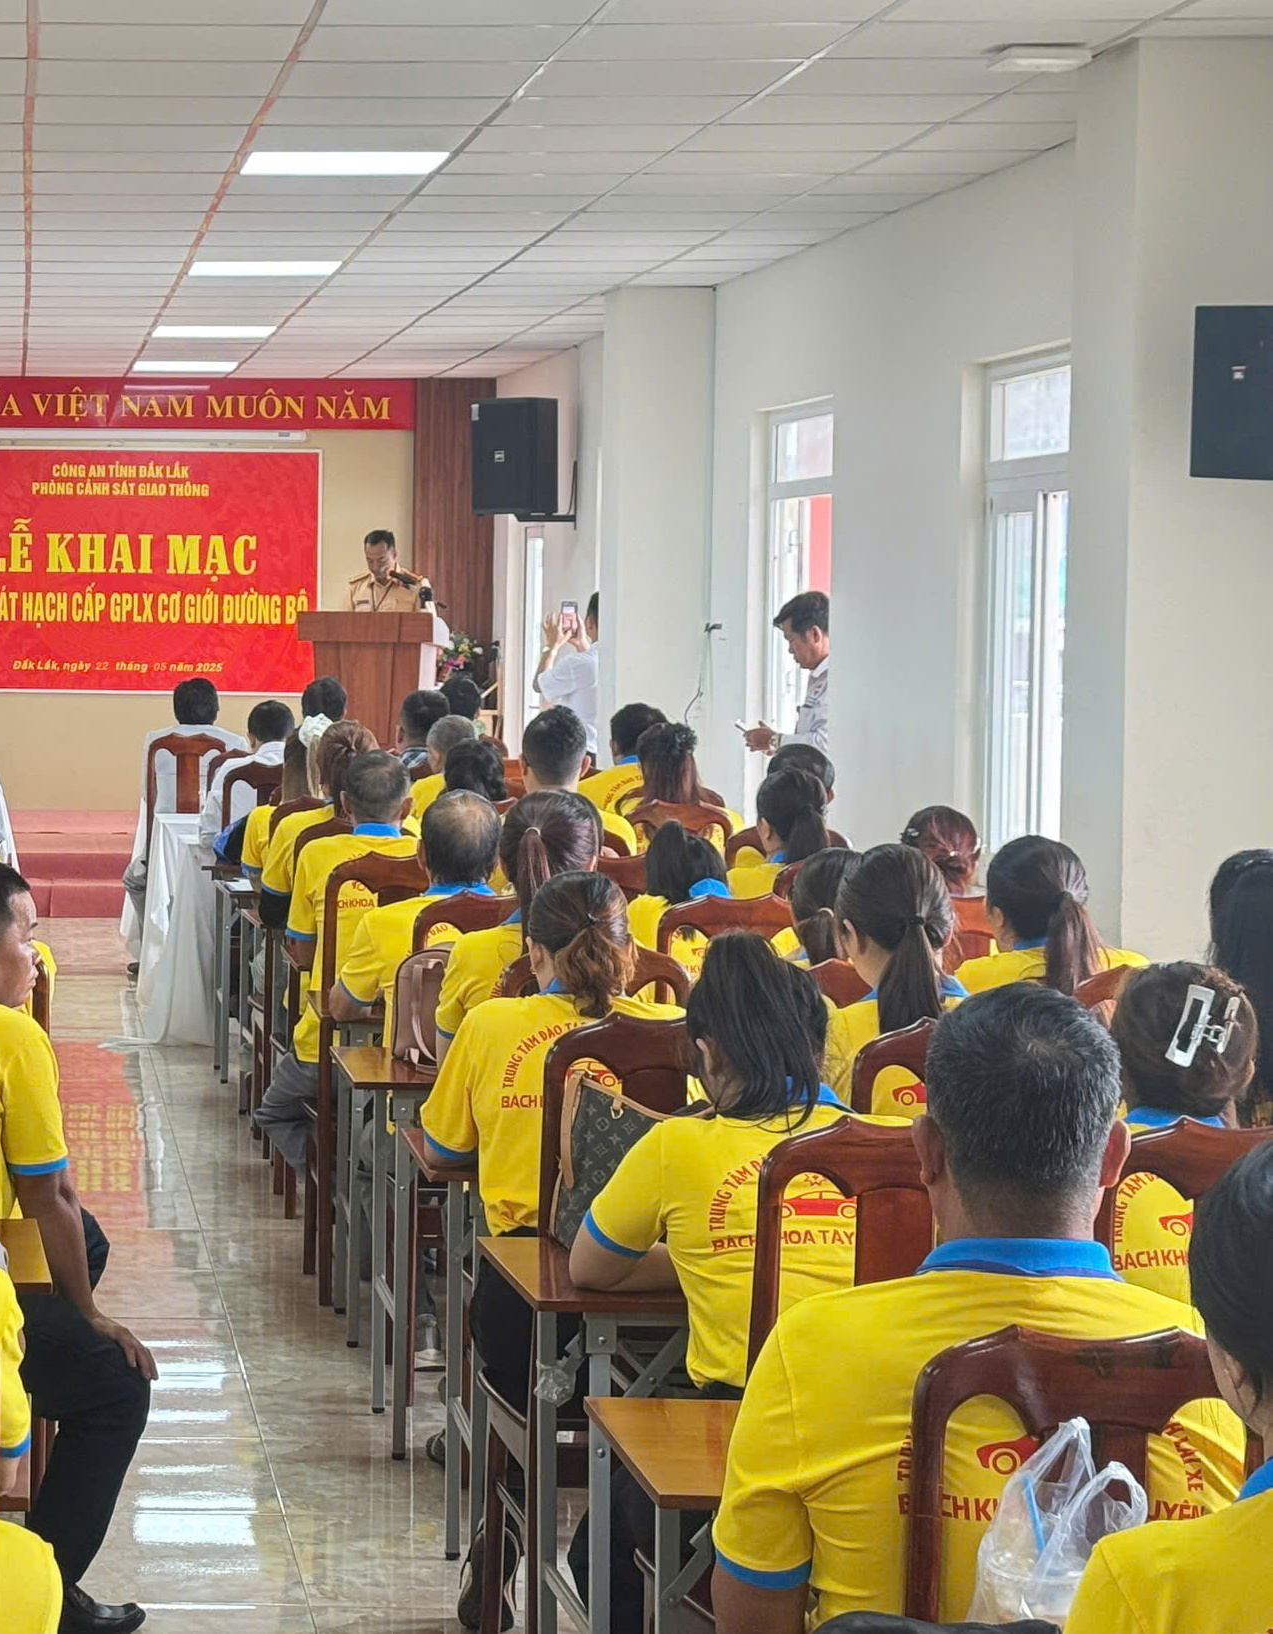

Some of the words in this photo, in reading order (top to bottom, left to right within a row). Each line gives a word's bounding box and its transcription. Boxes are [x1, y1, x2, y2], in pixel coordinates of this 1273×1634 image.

[32, 387, 110, 424] VIỆT
[120, 394, 194, 418] NAM
[205, 388, 305, 419] MUÔN
[315, 390, 391, 420] NĂM
[52, 461, 87, 478] CÔNG
[89, 465, 107, 478] AN
[108, 461, 137, 478] TỈNH
[32, 479, 74, 495] PHÒNG
[76, 479, 110, 495] CẢNH
[112, 480, 136, 495] SÁT
[138, 483, 167, 496] GIAO
[169, 481, 210, 497] THÔNG
[46, 532, 154, 575] KHAI
[166, 534, 258, 582] MẠC
[22, 591, 68, 628] HẠCH
[71, 582, 107, 623] CẤP
[110, 592, 155, 623] GPLX
[158, 591, 182, 623] CƠ
[184, 587, 219, 624] GIỚI
[222, 588, 282, 625] ĐƯỜNG
[12, 659, 35, 670] Đắk
[62, 661, 91, 673] ngày
[95, 662, 109, 671] 22
[115, 661, 149, 673] tháng
[153, 662, 167, 671] 05
[169, 662, 194, 672] năm
[196, 662, 223, 672] 2025
[502, 1053, 523, 1089] TRUNG
[501, 1092, 538, 1109] BÁCH
[709, 1189, 733, 1232] TRUNG
[722, 1165, 754, 1190] TÂM
[781, 1229, 816, 1245] HOA
[818, 1229, 855, 1245] TÂY
[1113, 1249, 1160, 1271] BÁCH
[1160, 1249, 1187, 1266] KH
[1185, 1468, 1204, 1492] XE
[897, 1493, 971, 1521] BCH
[1148, 1499, 1206, 1521] UYÊN
